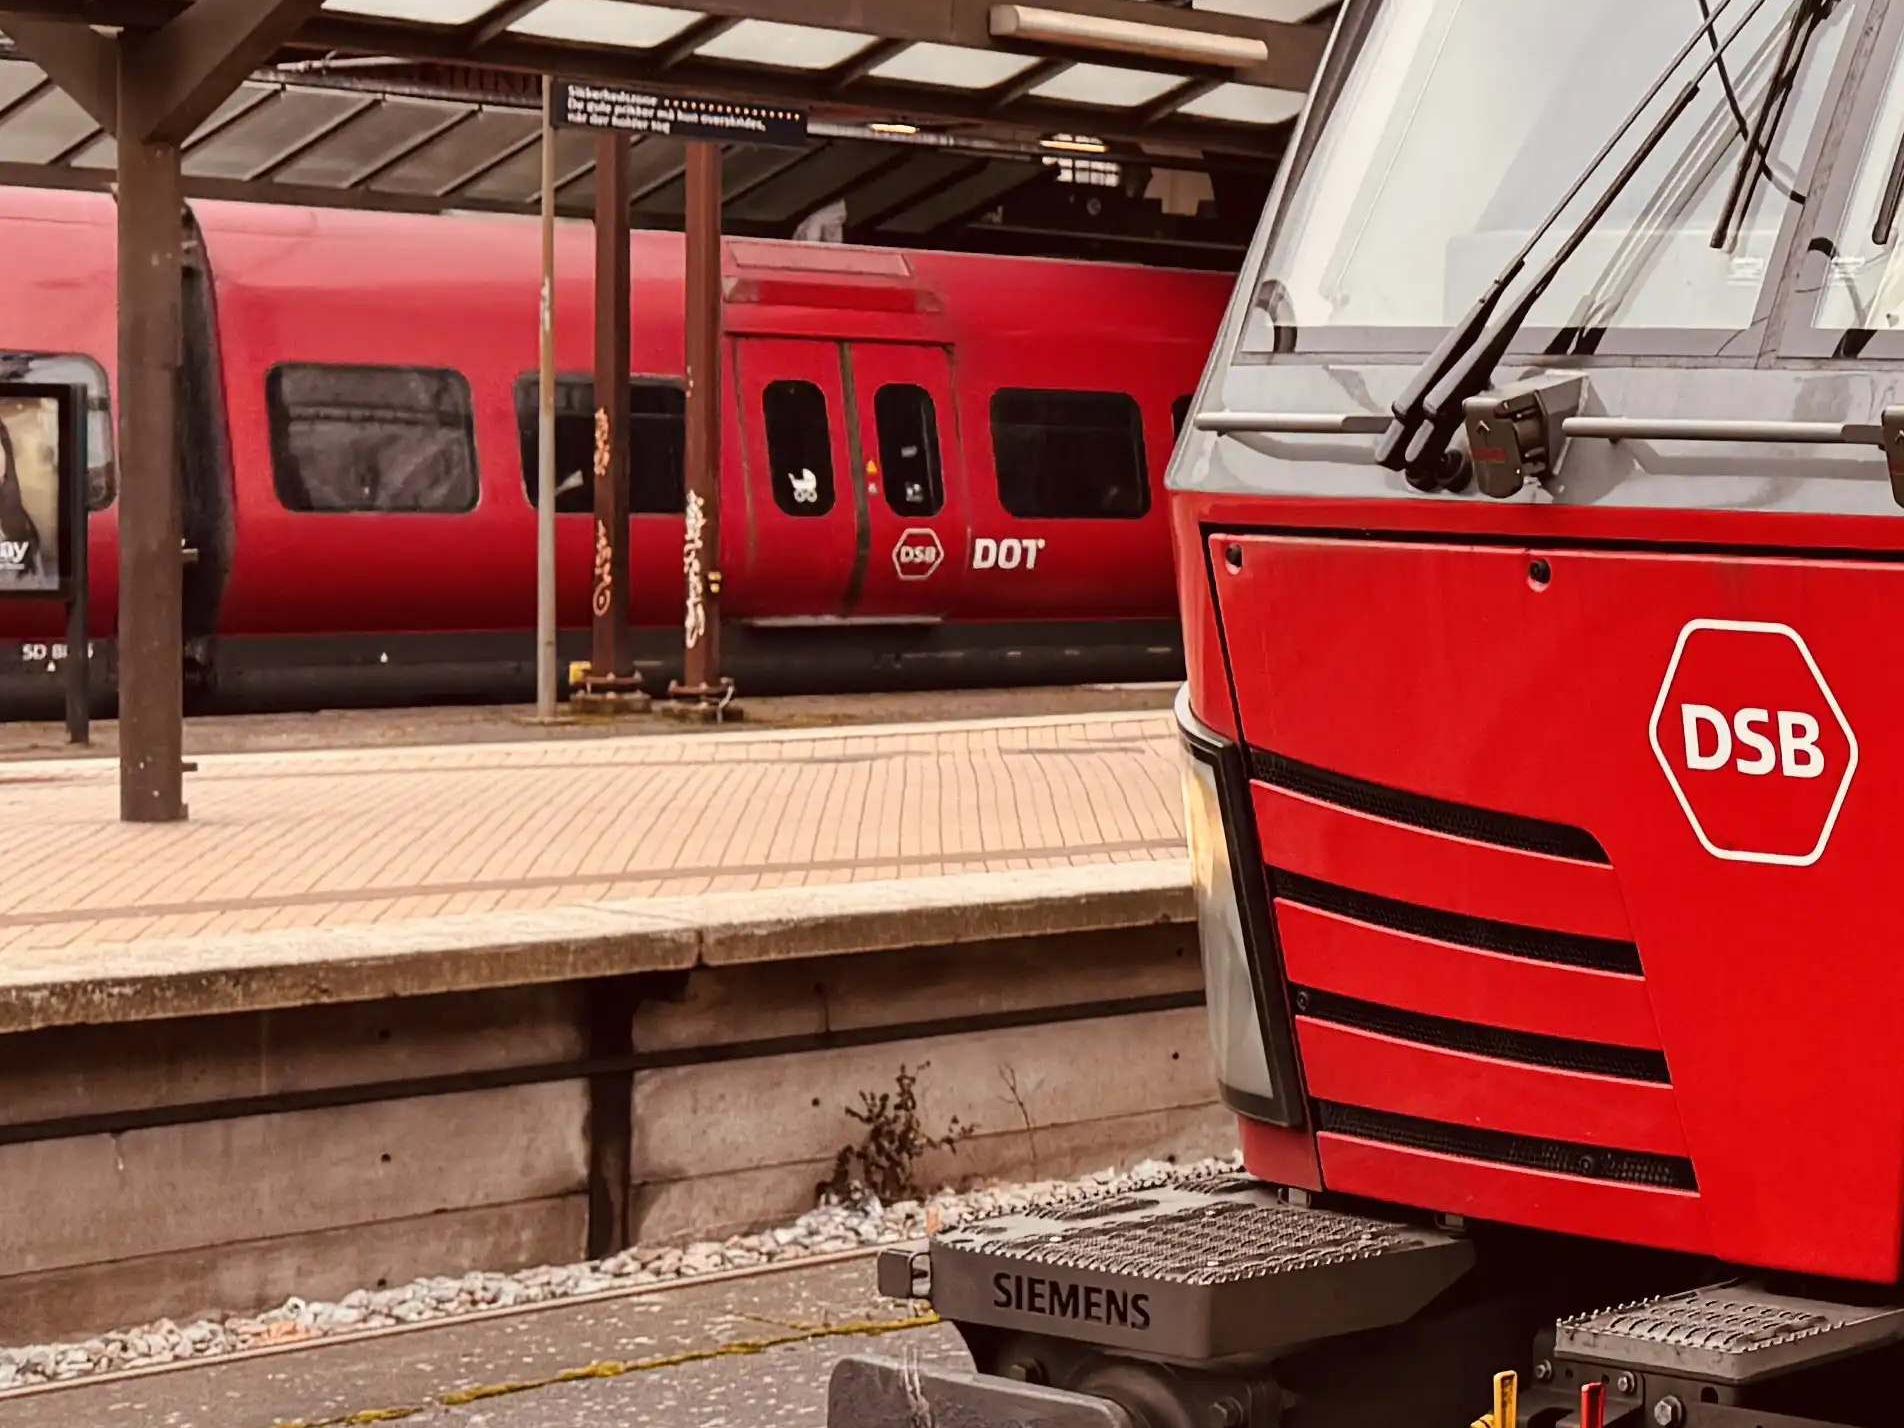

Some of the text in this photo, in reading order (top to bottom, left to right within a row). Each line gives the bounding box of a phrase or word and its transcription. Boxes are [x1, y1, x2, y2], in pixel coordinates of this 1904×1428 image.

[900, 545, 937, 564] DSB
[972, 538, 1041, 570] DOT
[1681, 703, 1826, 779] DSB
[993, 1272, 1151, 1331] SIEMENS
